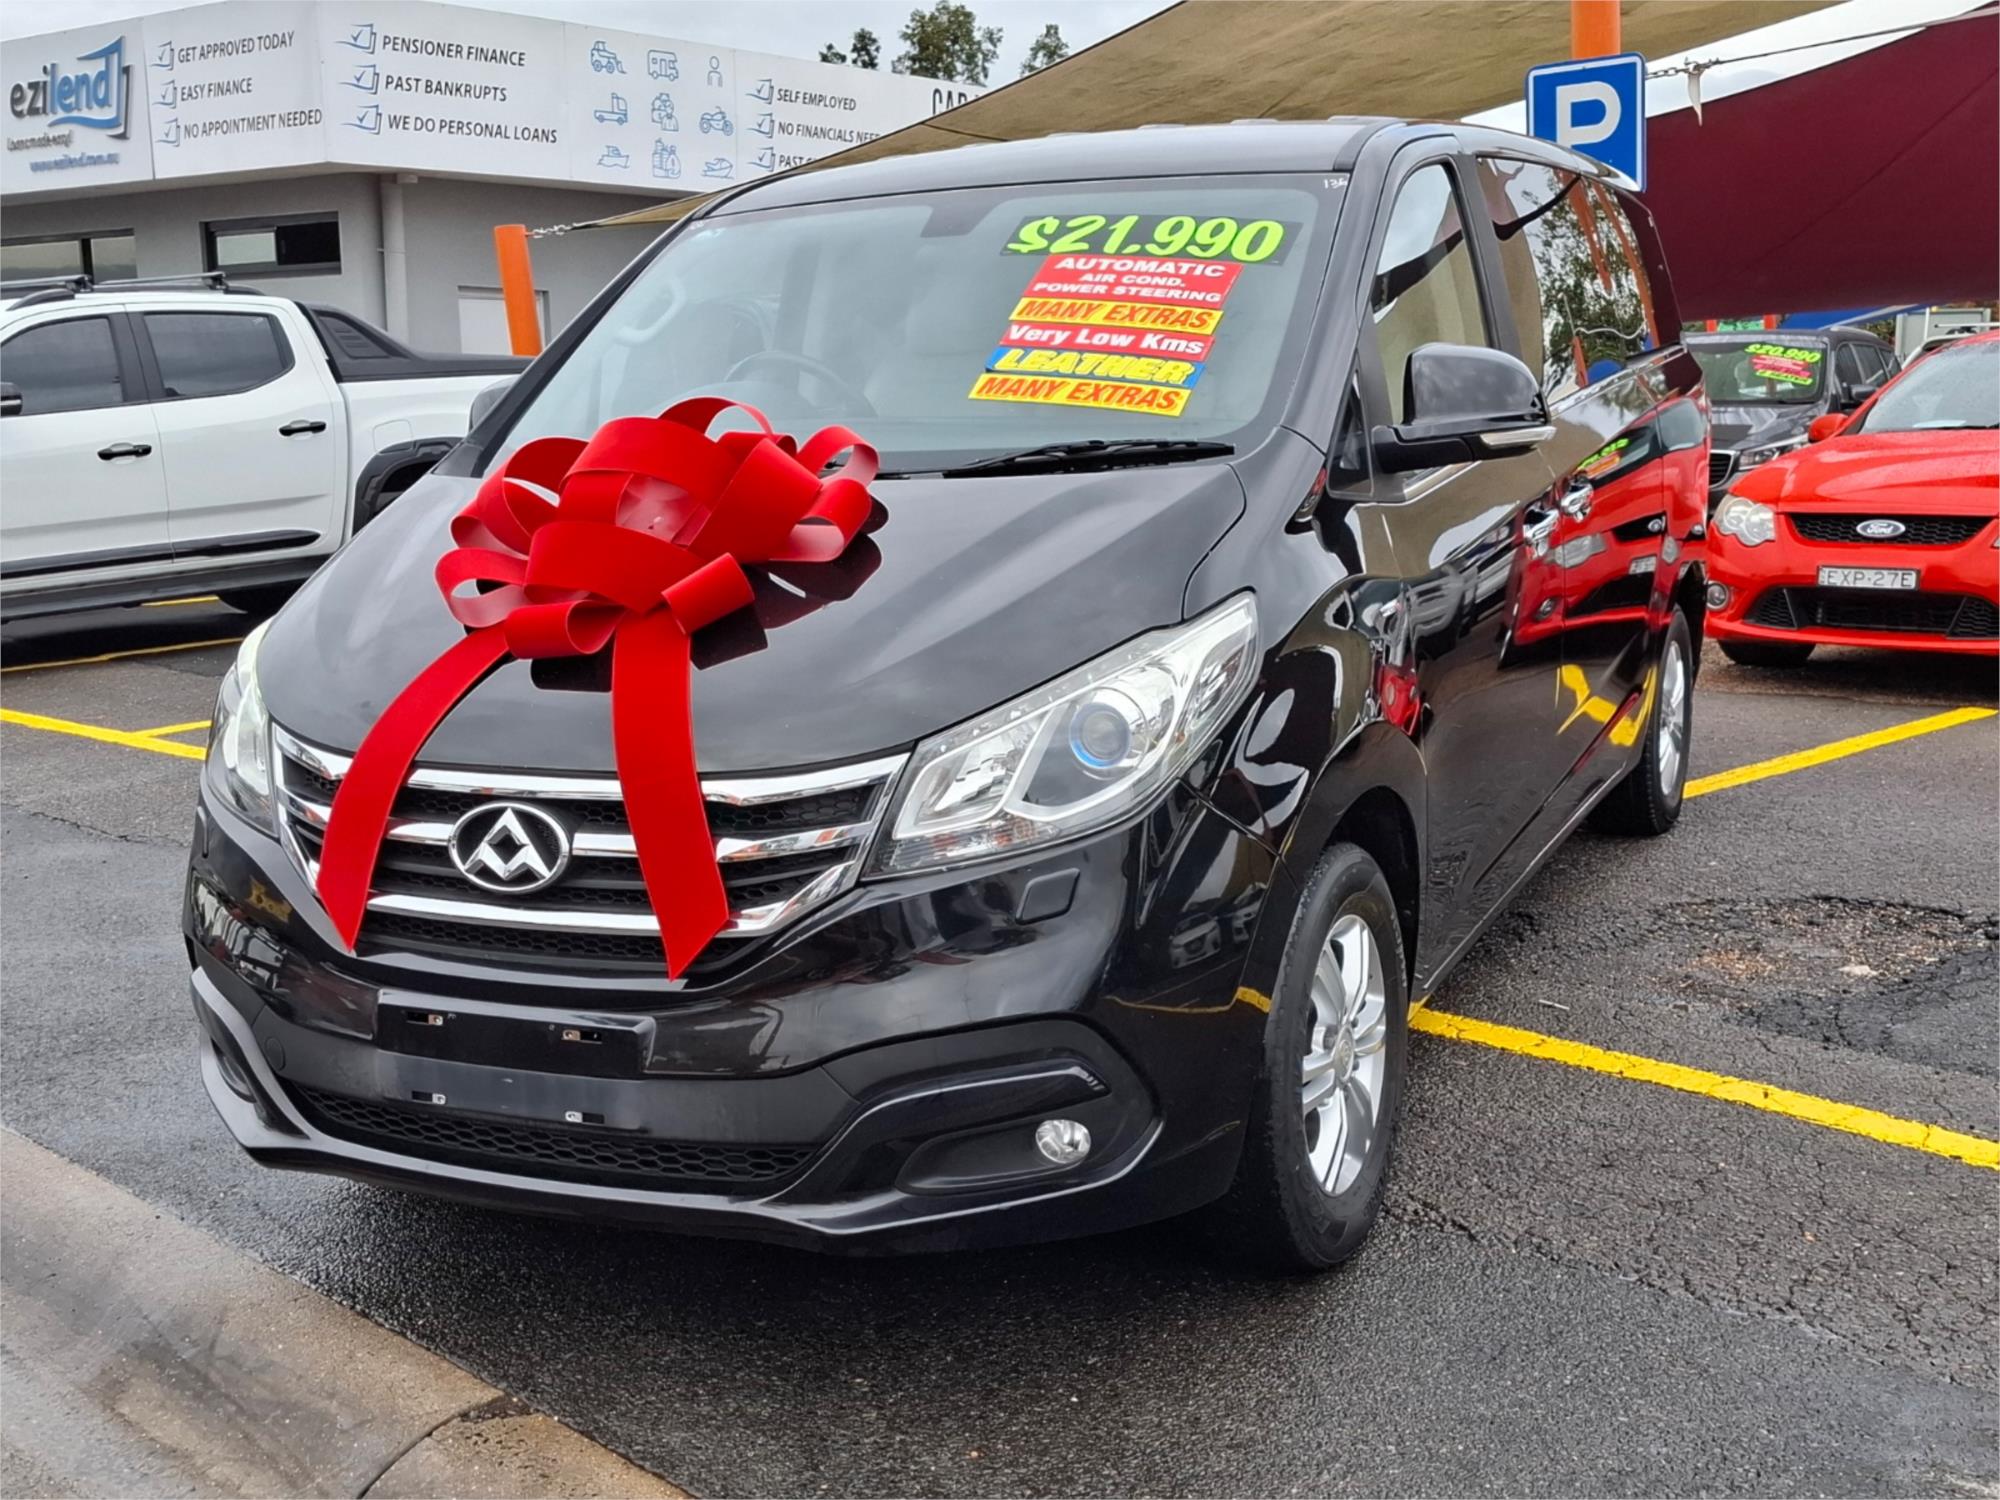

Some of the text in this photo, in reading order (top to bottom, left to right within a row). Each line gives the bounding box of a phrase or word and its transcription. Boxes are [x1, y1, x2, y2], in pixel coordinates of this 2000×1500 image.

[178, 31, 294, 63] GET APPROVED TODAY
[382, 35, 526, 66] PENSIONER FINANCE
[181, 77, 252, 101] EASY FINANCE
[385, 75, 507, 101] PAST BANKRUPTS
[777, 88, 856, 111] SELF EMPLOYED
[184, 109, 322, 139] NO APPOINTMENT NEEDED
[388, 114, 558, 143] WE DO PERSONAL LOANS
[1556, 81, 1622, 149] P
[778, 121, 794, 135] NO
[796, 123, 854, 143] FINANCIALS
[779, 154, 804, 167] PAST
[1007, 214, 1285, 263] $21.990
[1055, 257, 1227, 278] AUTOMATIC
[1080, 273, 1186, 288] AIR COND.
[1034, 282, 1222, 303] POWER STEERING
[1016, 300, 1214, 330] MANY EXTRAS
[1009, 325, 1205, 354] Very Low Kms
[994, 348, 1195, 385] LEATHER
[976, 377, 1181, 411] MANY EXTRAS
[1866, 523, 1894, 534] Ford
